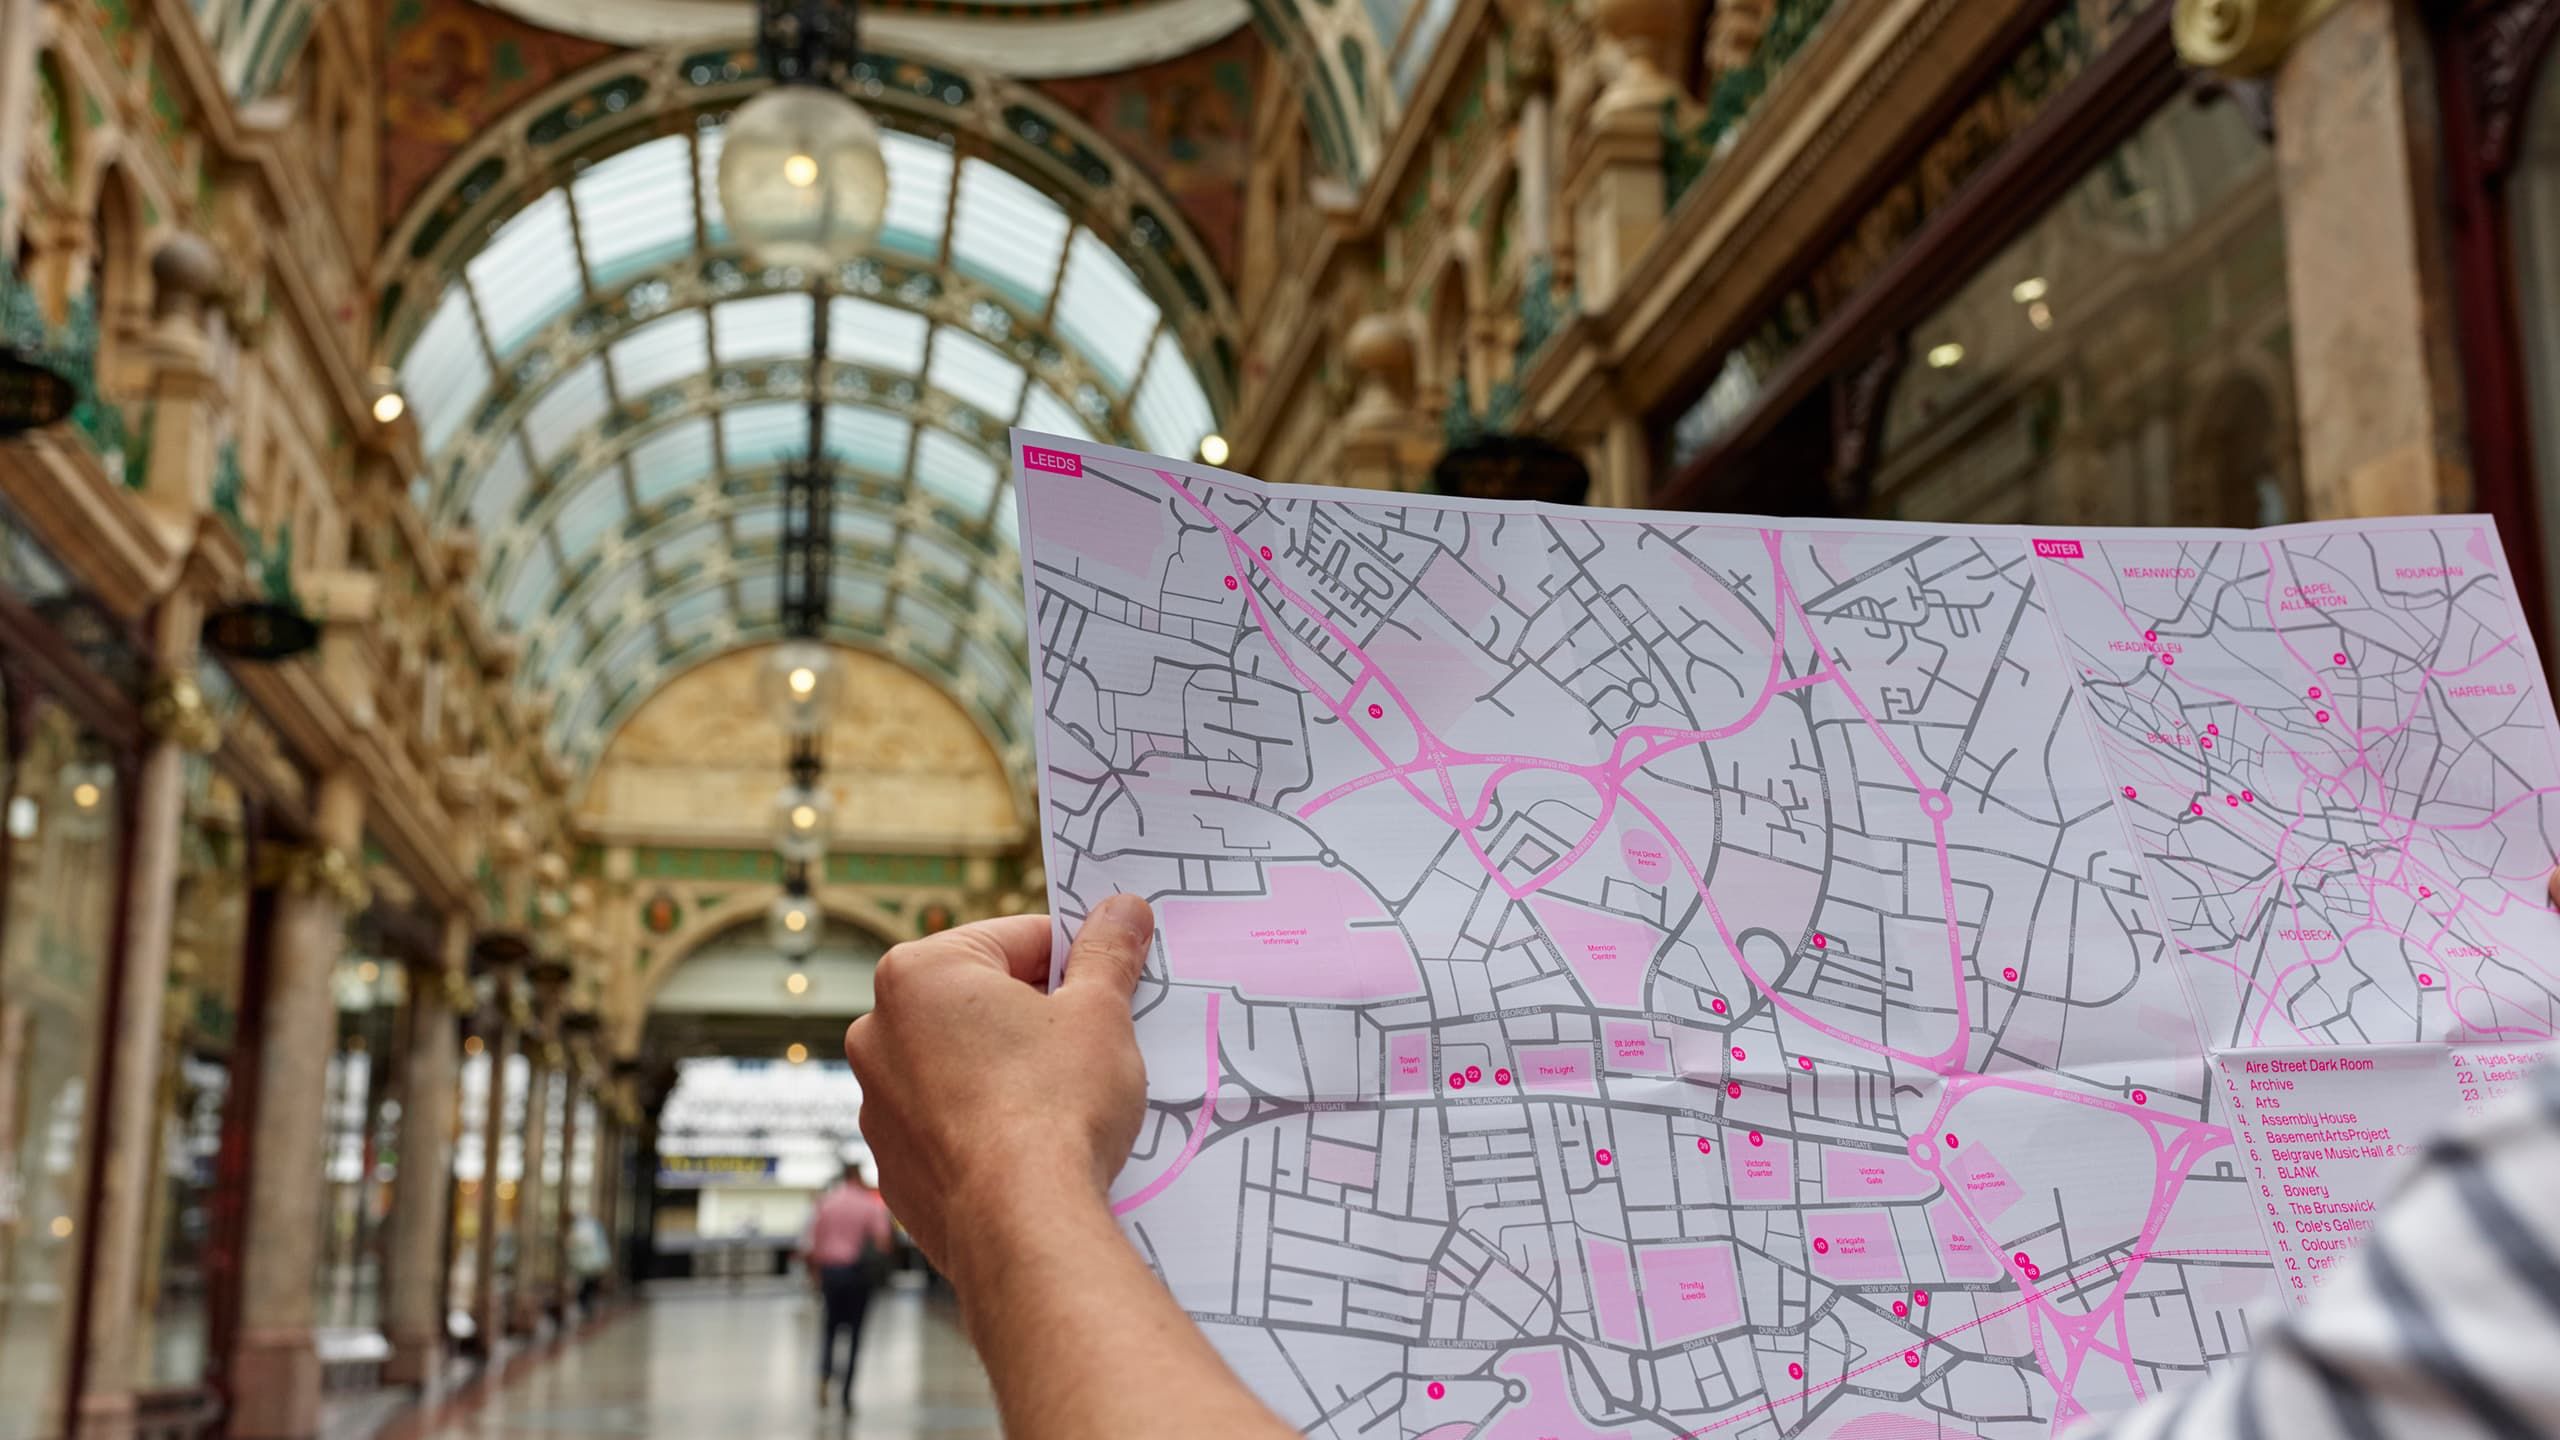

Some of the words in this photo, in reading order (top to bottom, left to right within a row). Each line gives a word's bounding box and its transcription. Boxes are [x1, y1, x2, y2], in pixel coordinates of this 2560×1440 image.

[1029, 451, 1077, 472] LEEDS
[2038, 542, 2079, 555] OUTER
[2123, 567, 2196, 579] MEANWOOD
[2395, 566, 2464, 579] ROUNDHAY
[2284, 583, 2336, 597] CHAPEL
[2280, 596, 2347, 611] ALLERTON
[2108, 640, 2183, 654] HEADINGLEY
[2449, 683, 2516, 697] HAREHILLS
[2147, 732, 2191, 745] BURLEY
[1250, 930, 1276, 938] Leeds
[1276, 928, 1307, 936] General
[2278, 929, 2335, 941] HOLBECK
[1534, 925, 1567, 970] WOODHOUSE
[1563, 968, 1575, 981] LN
[1587, 945, 1616, 953] Merrion
[2446, 945, 2500, 957] HUNSLET
[1592, 953, 1616, 961] Centre
[1647, 965, 1659, 984] WADE
[1473, 1011, 1498, 1022] GREAT
[1501, 1007, 1531, 1018] GEORGE
[1532, 1006, 1542, 1014] ST
[1675, 1017, 1684, 1025] ST
[1614, 1039, 1623, 1047] St
[1623, 1039, 1645, 1047] Johns
[1619, 1048, 1644, 1057] Centre
[1399, 1056, 1420, 1065] Town
[2221, 1062, 2230, 1074] 1.
[2246, 1061, 2269, 1073] Aire
[2271, 1060, 2307, 1073] Street
[2310, 1060, 2338, 1072] Dark
[2340, 1059, 2374, 1071] Room
[2453, 1055, 2470, 1067] 21.
[2476, 1055, 2508, 1068] Hyde
[2508, 1053, 2534, 1065] Park
[1403, 1066, 1418, 1074] Hall
[1432, 1045, 1441, 1094] CALVERLEY
[1468, 1070, 1479, 1080] 22
[1539, 1067, 1553, 1075] The
[1553, 1066, 1575, 1075] Light
[1452, 1076, 1462, 1086] 12
[1497, 1072, 1509, 1082] 20
[2457, 1071, 2478, 1084] 22.
[2483, 1070, 2519, 1082] Leeds
[2227, 1079, 2238, 1091] 2.
[2250, 1078, 2294, 1091] Archive
[2462, 1088, 2483, 1101] 23.
[1304, 1103, 1347, 1111] WESTGATE
[1471, 1097, 1513, 1105] HEADROW
[2233, 1096, 2244, 1109] 3.
[2256, 1097, 2280, 1108] Arts
[1680, 1109, 1694, 1118] THE
[1695, 1112, 1730, 1126] HEADROW
[2237, 1114, 2250, 1126] 4.
[2261, 1114, 2319, 1128] Assembly
[2320, 1112, 2357, 1124] House
[2244, 1132, 2256, 1144] 5.
[2266, 1128, 2391, 1144] BasementArtsProject
[1836, 1138, 1873, 1150] EASTGATE
[1440, 1135, 1451, 1168] PARADE
[1598, 1153, 1610, 1162] 15
[2250, 1150, 2262, 1162] 6.
[2272, 1148, 2323, 1164] Belgrave
[2324, 1147, 2360, 1160] Music
[2360, 1146, 2384, 1158] Hall
[2386, 1144, 2396, 1157] &
[1744, 1159, 1771, 1168] Victoria
[1747, 1169, 1773, 1178] Quarter
[1971, 1171, 1995, 1181] Leeds
[2255, 1167, 2265, 1179] 7.
[2278, 1166, 2319, 1179] BLANK
[1445, 1169, 1454, 1191] EAST
[1866, 1176, 1883, 1185] Gate
[1967, 1180, 2005, 1190] Playhouse
[2262, 1185, 2273, 1197] 8.
[2283, 1184, 2329, 1199] Bowery
[2267, 1203, 2279, 1216] 9.
[2288, 1202, 2313, 1215] The
[2313, 1200, 2376, 1214] Brunswick
[2273, 1221, 2288, 1234] 10.
[2296, 1220, 2332, 1233] Cole's
[2333, 1218, 2376, 1232] Gallery
[1816, 1241, 1827, 1250] 10
[1836, 1237, 1865, 1246] Kirkgate
[1950, 1243, 1972, 1251] Station
[2279, 1239, 2292, 1252] 11.
[2301, 1238, 2346, 1251] Colours
[1840, 1246, 1865, 1254] Market
[2018, 1255, 2027, 1264] 11
[2285, 1257, 2300, 1270] 12.
[2307, 1256, 2336, 1270] Craft
[1428, 1269, 1437, 1282] ST
[2026, 1266, 2038, 1276] 18
[1680, 1282, 1704, 1291] Trinity
[1963, 1283, 1981, 1291] YORK
[1982, 1283, 1991, 1291] ST
[2291, 1276, 2306, 1289] 13.
[1426, 1283, 1436, 1303] KING
[1861, 1286, 1878, 1294] NEW
[1879, 1285, 1901, 1294] YORK
[1902, 1285, 1910, 1293] ST
[1682, 1292, 1706, 1301] Leeds
[1814, 1304, 1828, 1321] CALL
[1825, 1296, 1837, 1308] LN
[1190, 1312, 1249, 1325] WELLINGTON
[1249, 1318, 1260, 1327] ST
[1875, 1307, 1912, 1330] KIRKGATE
[1758, 1326, 1787, 1336] DUNCAN
[1787, 1326, 1799, 1336] ST
[1427, 1339, 1485, 1349] WELLINGTON
[1486, 1341, 1498, 1349] ST
[1682, 1339, 1704, 1351] BOAR
[1704, 1335, 1719, 1346] LN
[1907, 1354, 1918, 1364] 35
[1983, 1355, 2018, 1366] KIRKGATE
[1922, 1371, 1938, 1388] HIGH
[1433, 1386, 1438, 1395] 1
[1857, 1388, 1871, 1397] THE
[1872, 1389, 1899, 1400] CALLS
